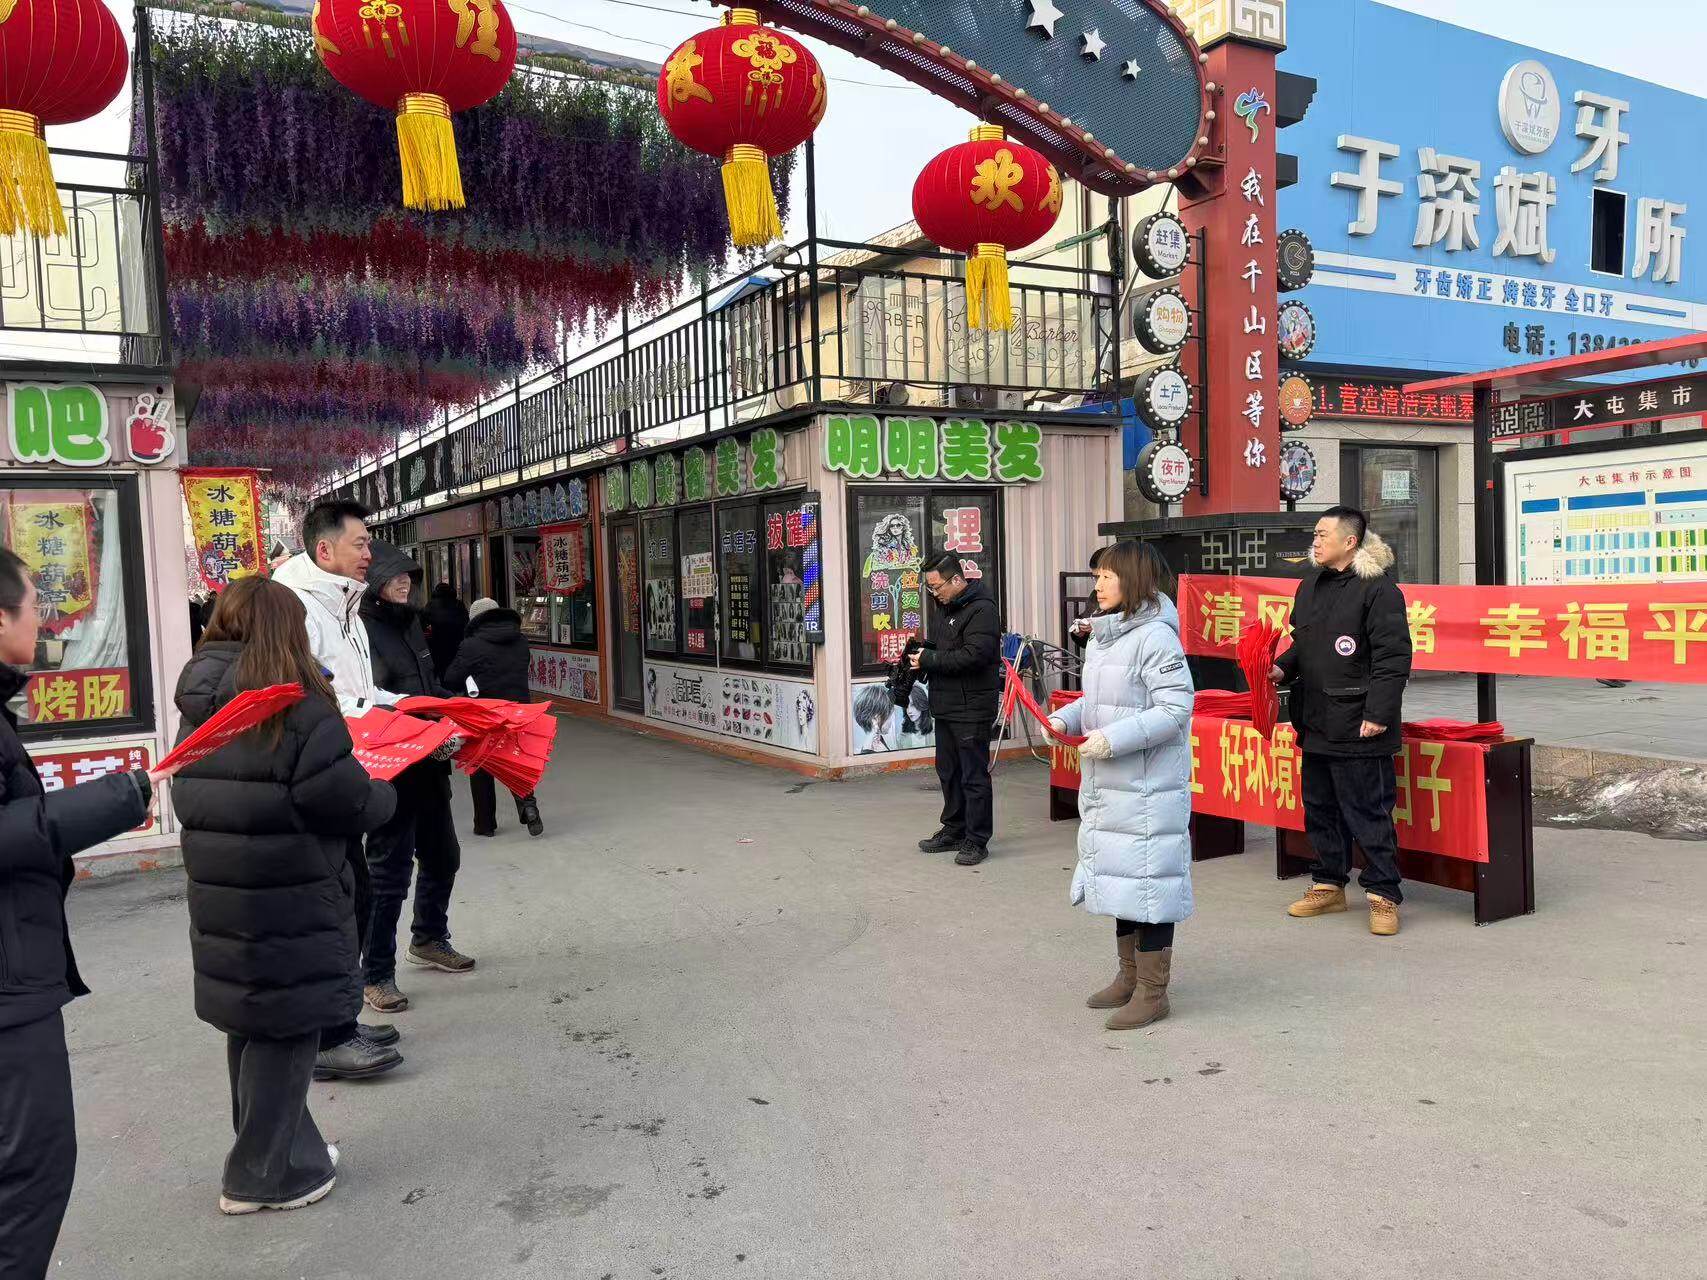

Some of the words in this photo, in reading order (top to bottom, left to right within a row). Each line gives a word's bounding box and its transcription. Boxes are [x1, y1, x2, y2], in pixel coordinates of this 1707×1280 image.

[1155, 229, 1181, 249] 赶集
[1157, 250, 1179, 260] Market
[1155, 306, 1184, 323] 购物
[1414, 267, 1492, 302] 牙齿矫正
[1503, 279, 1557, 310] 烤瓷牙
[1565, 286, 1615, 317] 全口牙
[1159, 325, 1183, 337] Shopping
[1240, 168, 1267, 468] 我在千山区等你
[1159, 382, 1182, 402] 土产
[1574, 385, 1692, 421] 大屯集市
[9, 381, 112, 466] 吧
[825, 415, 1043, 481] 明明美发
[1160, 457, 1185, 477] 夜市
[1579, 466, 1692, 488] 大屯集市示意图
[207, 484, 241, 576] 冰糖葫芦
[34, 510, 71, 603] 冰糖葫芦
[553, 536, 569, 587] 冰糖葫芦
[870, 571, 892, 630] 洗剪吹
[902, 571, 920, 630] 拉烫染
[32, 674, 125, 721] 烤肠
[1220, 720, 1302, 811] 好环境
